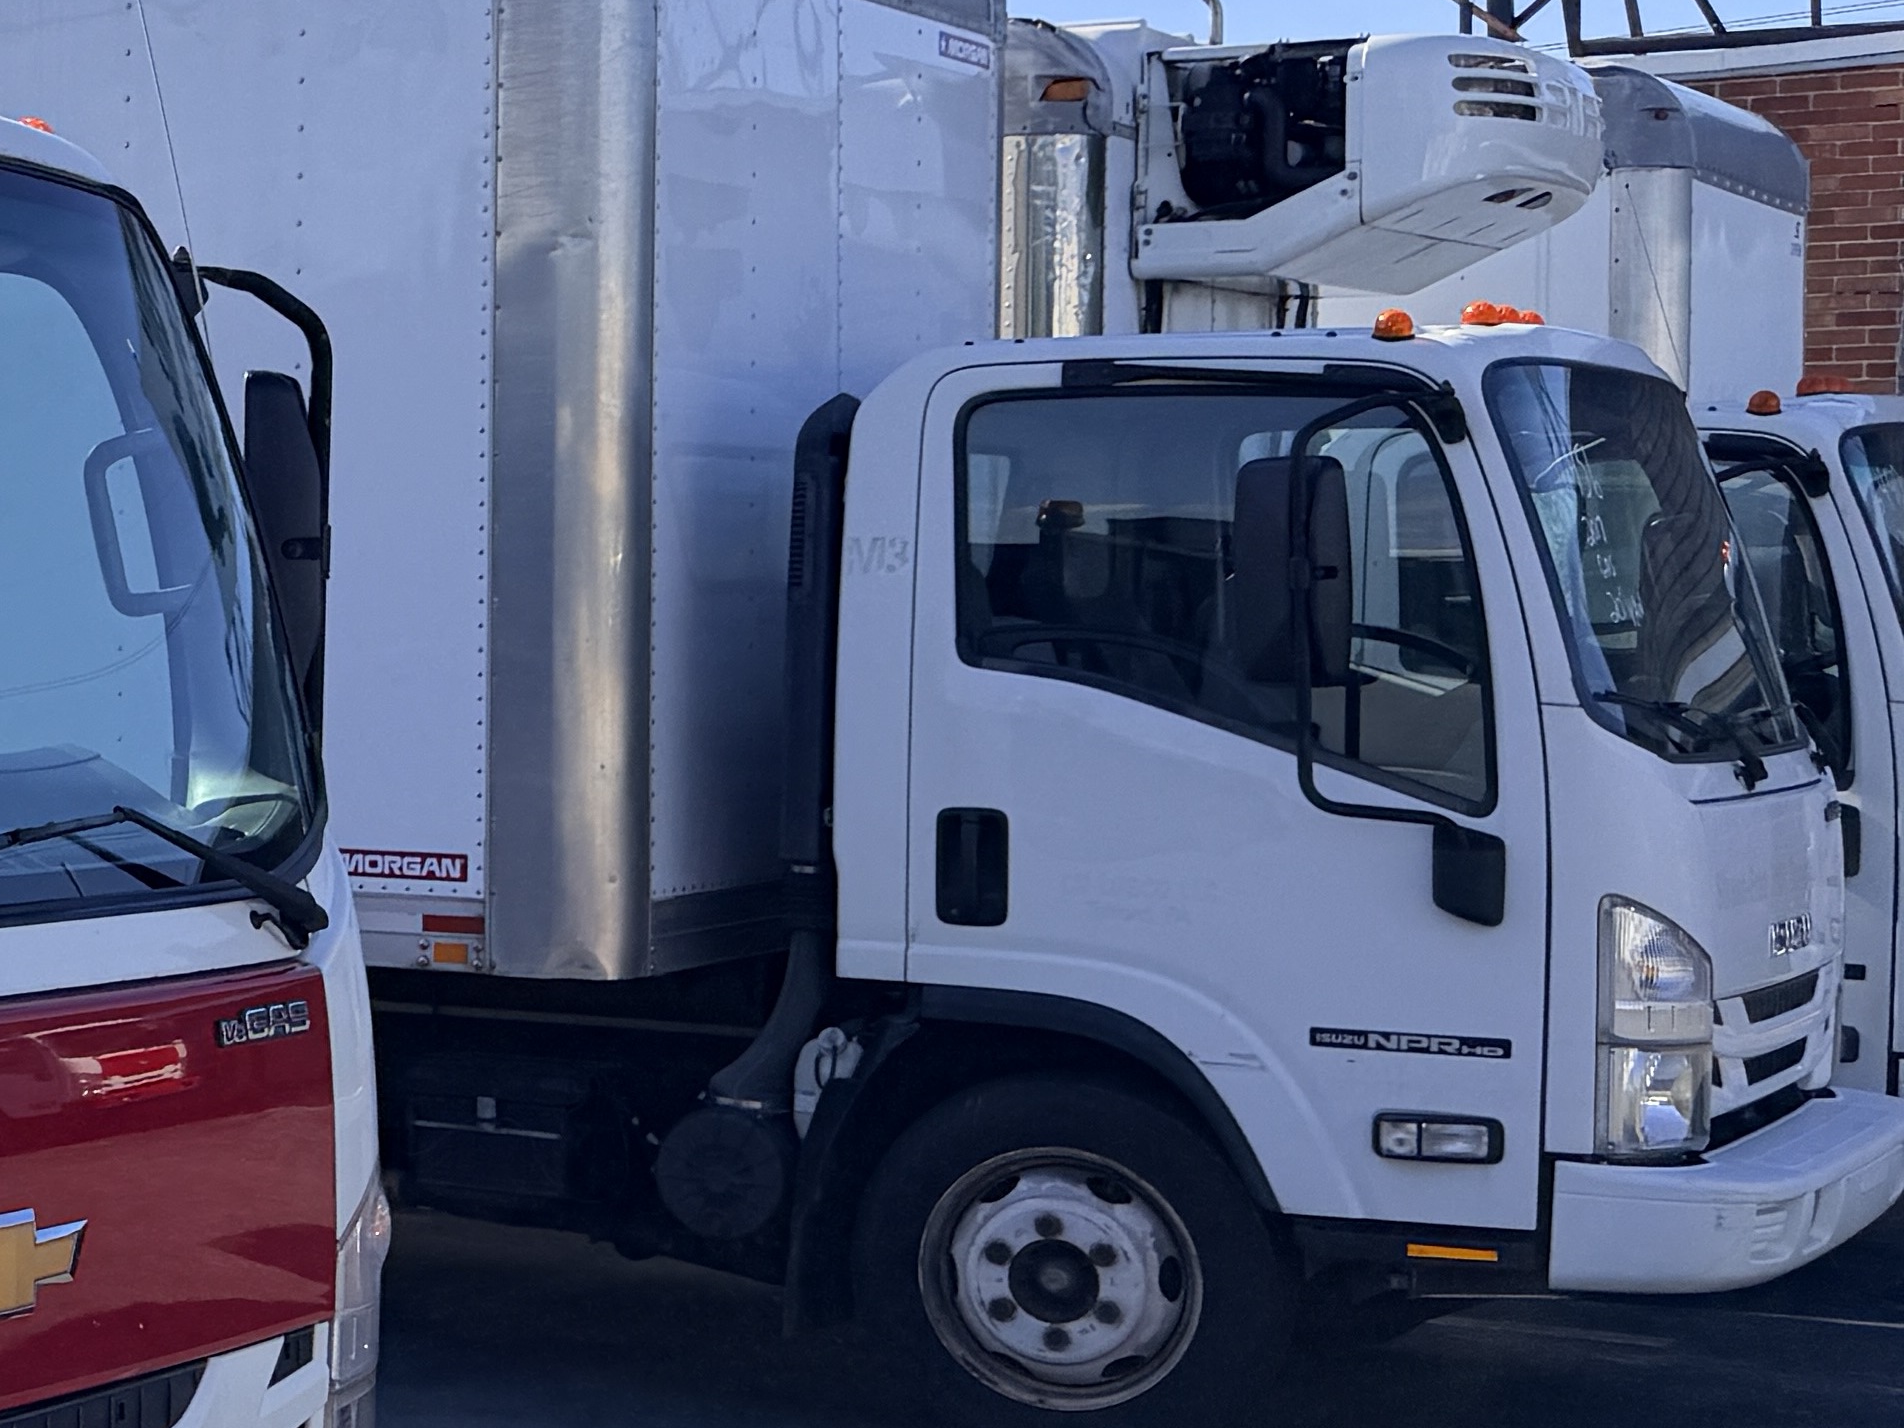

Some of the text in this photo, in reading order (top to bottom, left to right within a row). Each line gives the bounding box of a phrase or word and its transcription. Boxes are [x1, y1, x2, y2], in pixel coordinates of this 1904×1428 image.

[342, 853, 462, 879] MORGAN
[245, 1000, 310, 1040] GAS
[1315, 1032, 1365, 1046] ISUZU
[1367, 1033, 1462, 1055] NPR
